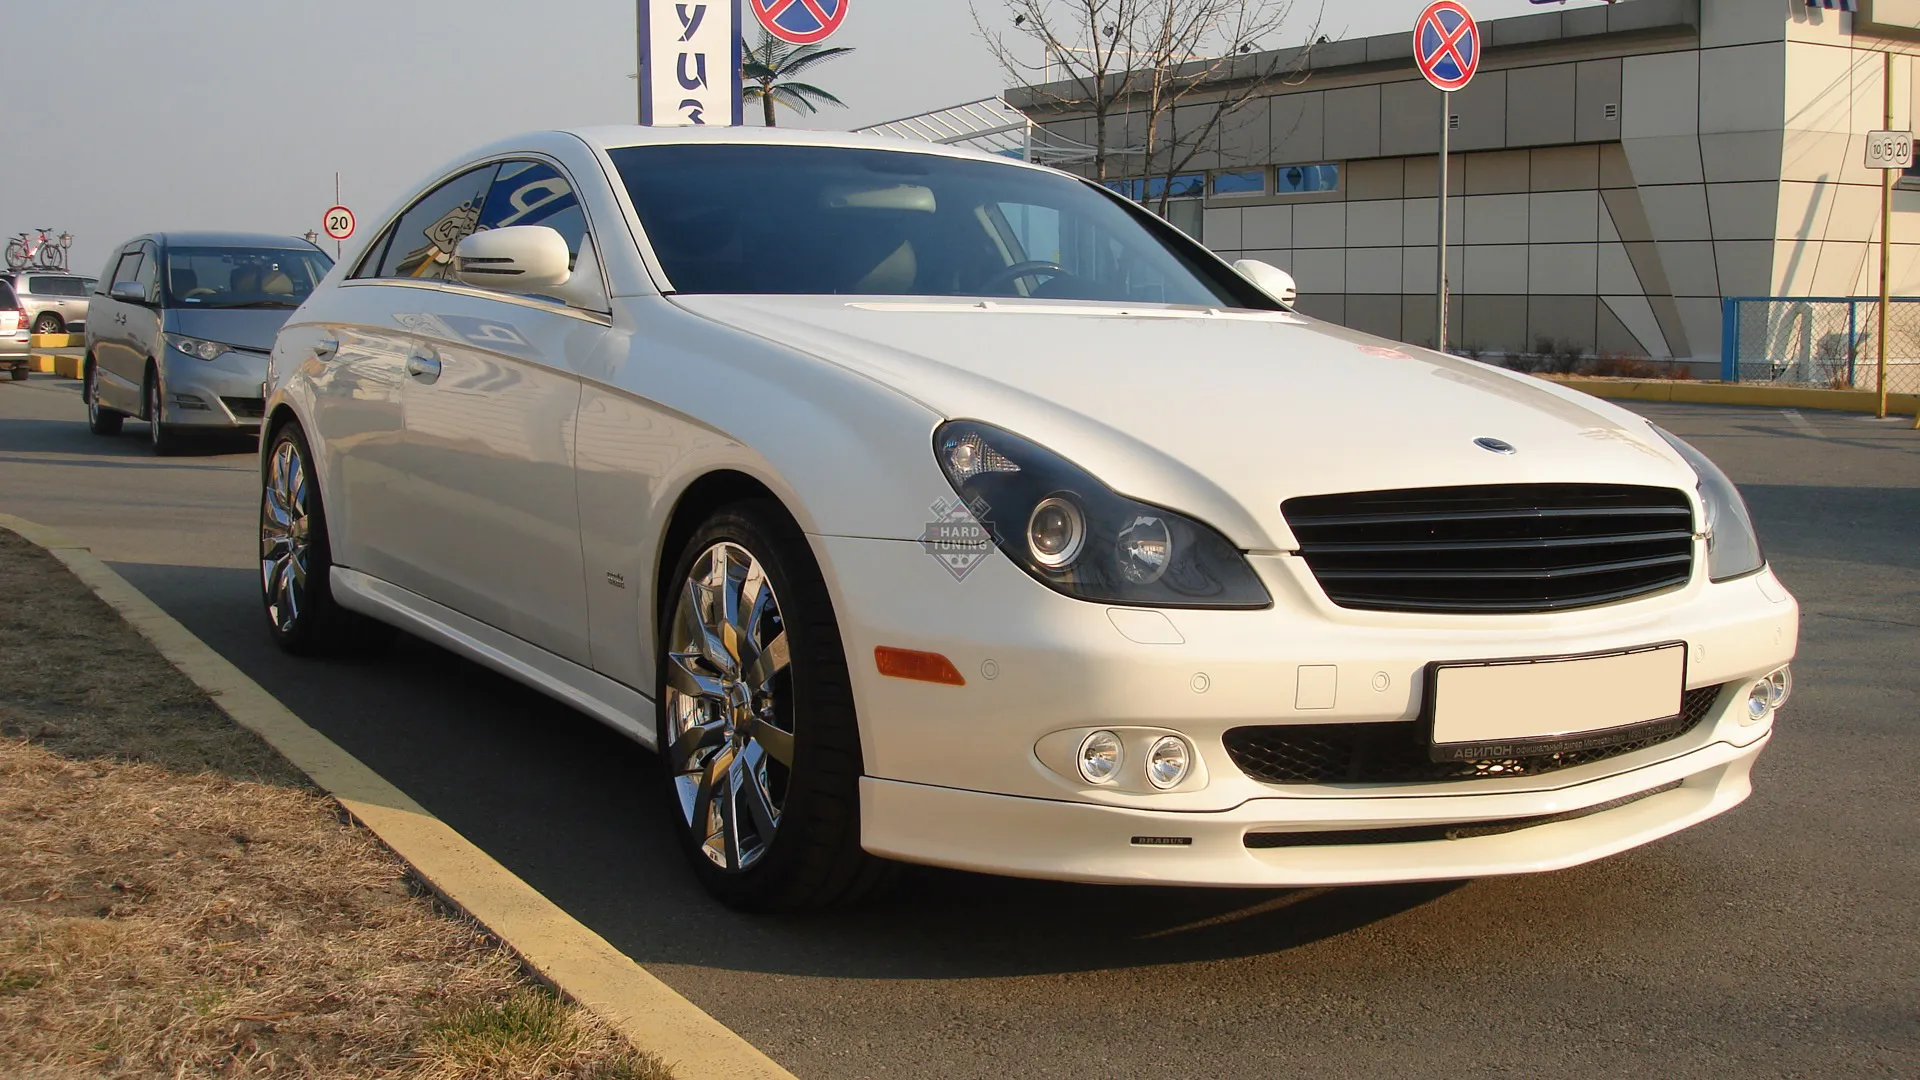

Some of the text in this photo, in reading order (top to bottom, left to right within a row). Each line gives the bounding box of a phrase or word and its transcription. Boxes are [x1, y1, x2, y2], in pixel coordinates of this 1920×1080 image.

[1873, 142, 1908, 157] 10 15 20
[330, 216, 349, 230] 20
